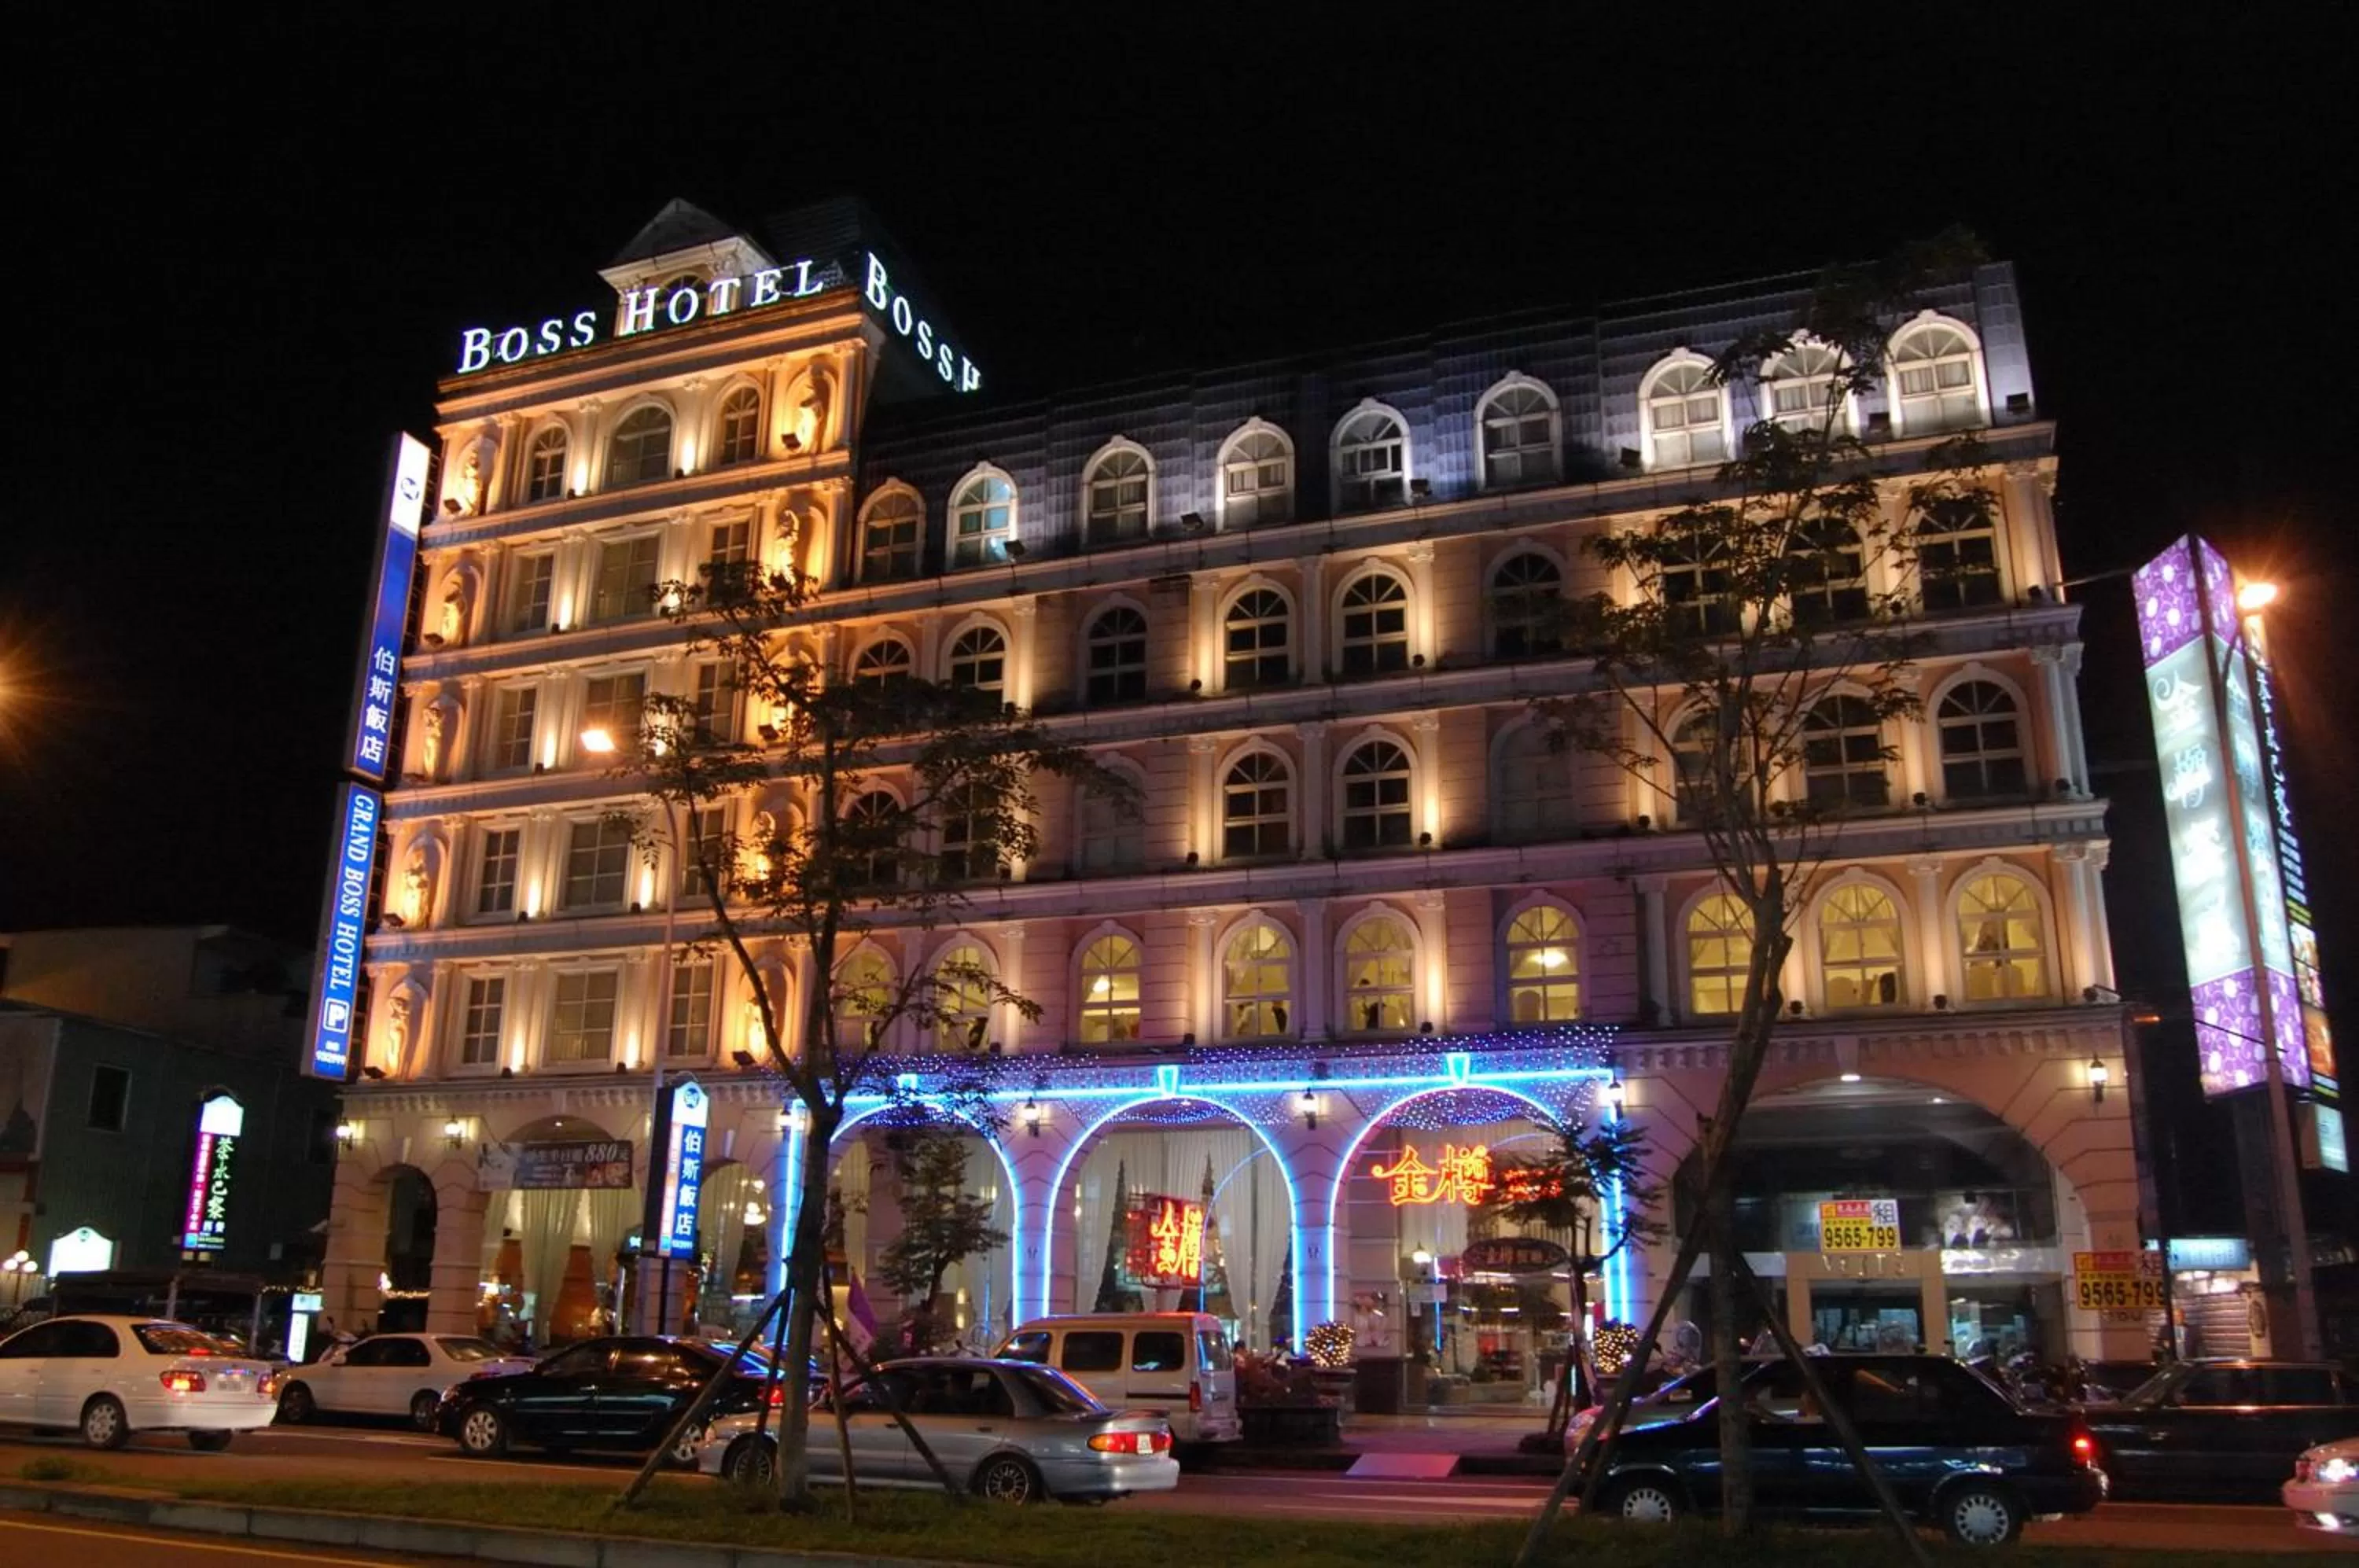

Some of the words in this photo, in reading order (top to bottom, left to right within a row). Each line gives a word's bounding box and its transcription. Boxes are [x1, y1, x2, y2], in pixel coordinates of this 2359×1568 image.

[621, 260, 826, 337] HOTEL
[359, 646, 396, 763] 伯斯飯店
[346, 794, 375, 863] GRAND
[339, 864, 365, 918] BOSS
[329, 921, 358, 991] HOTEL
[675, 1130, 702, 1236] 伯斯飯店
[1824, 1226, 1896, 1249] 9565-799
[2080, 1281, 2165, 1306] 9565-799
